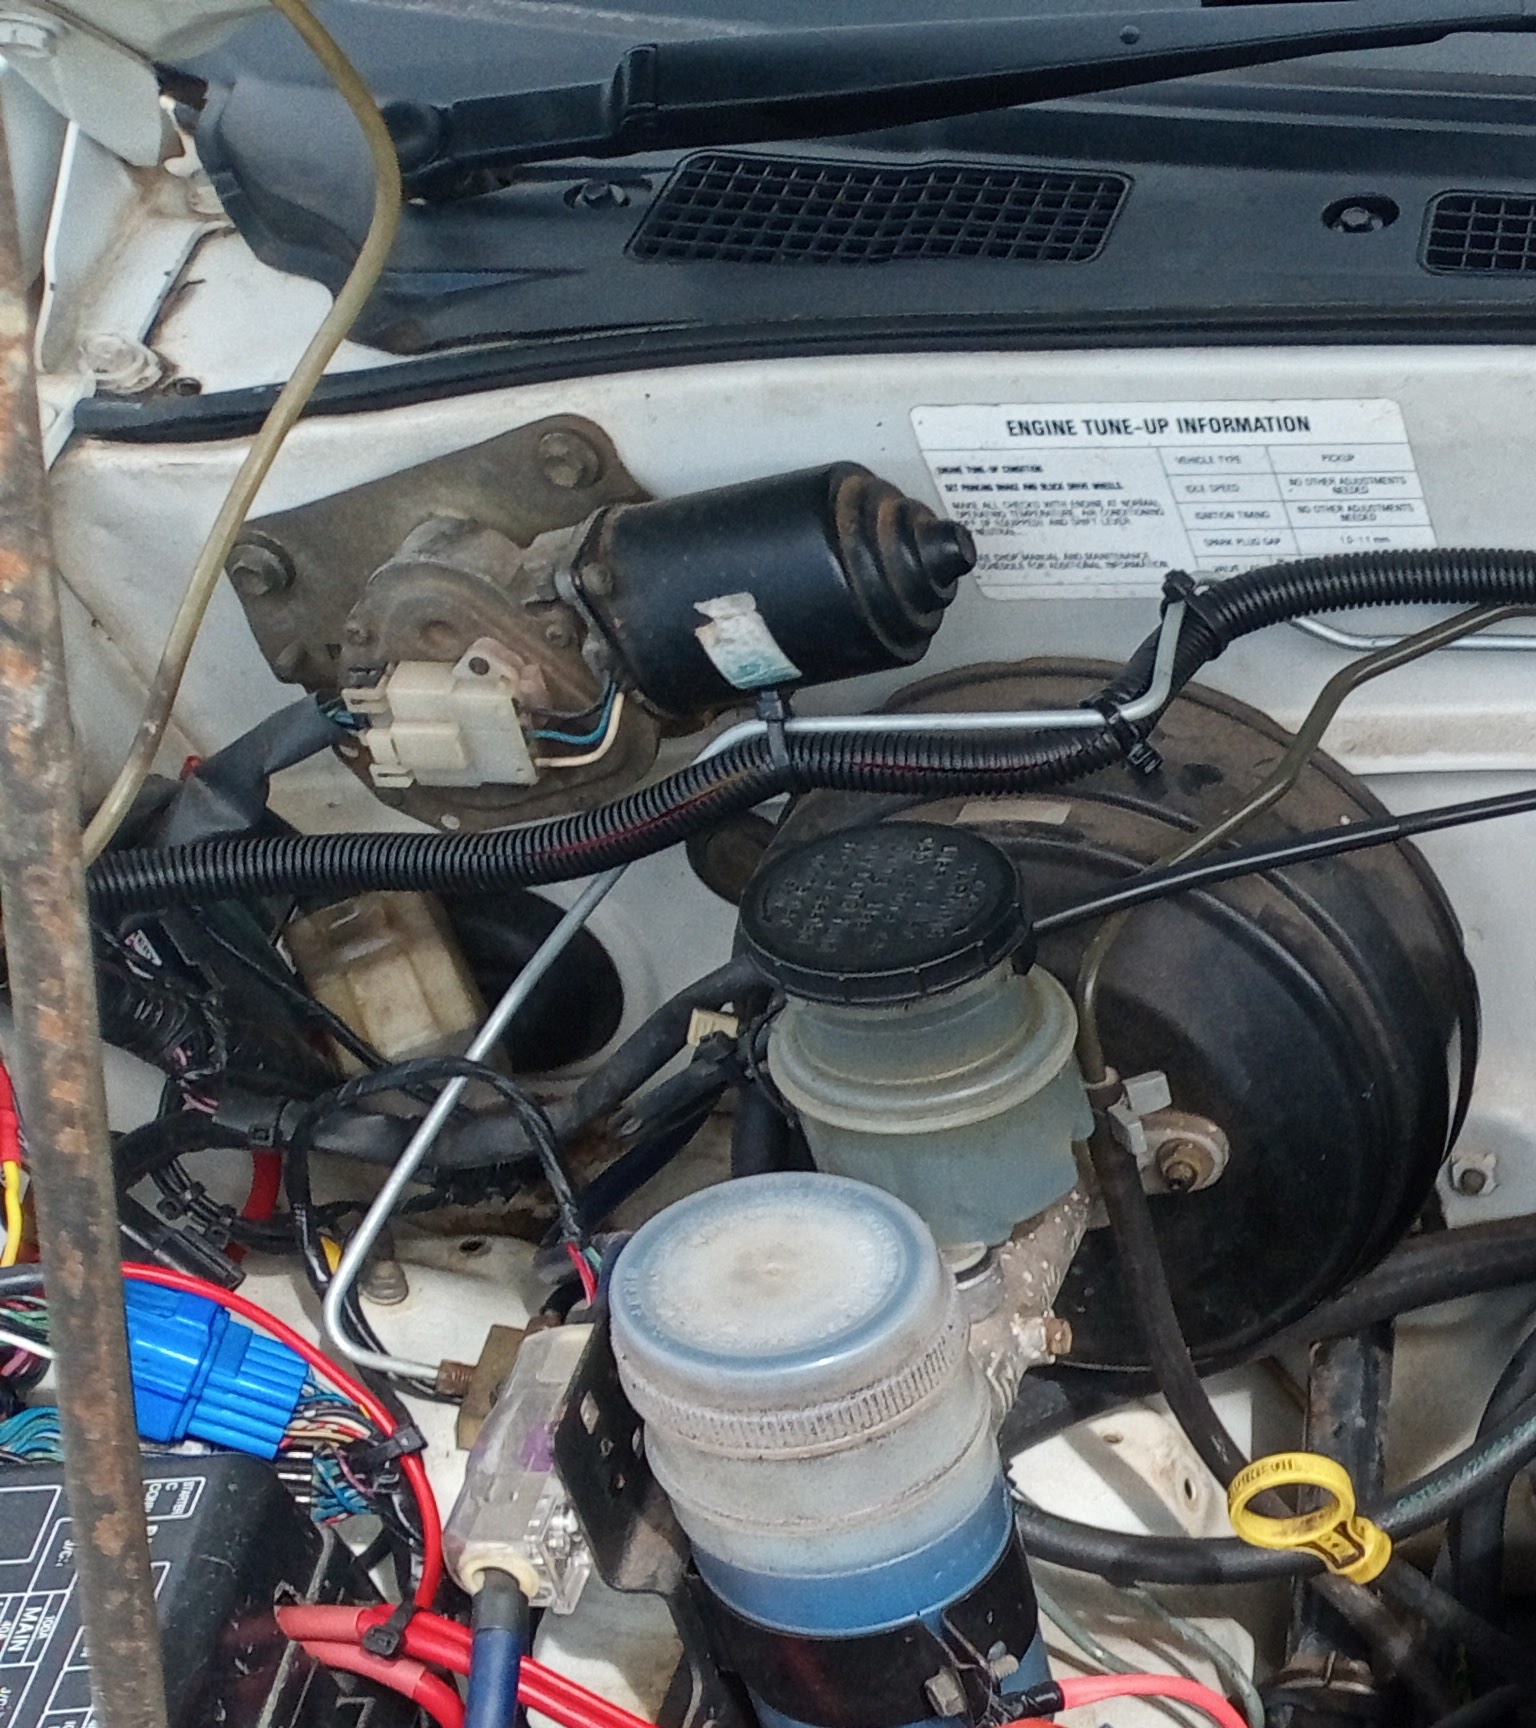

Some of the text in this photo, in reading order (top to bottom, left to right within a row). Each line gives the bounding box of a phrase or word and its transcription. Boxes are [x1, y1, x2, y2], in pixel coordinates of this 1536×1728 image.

[1007, 416, 1311, 436] ENGINE TUNE-UP INFORMATION
[173, 1480, 194, 1514] STARTER
[7, 1605, 41, 1652] MAIN
